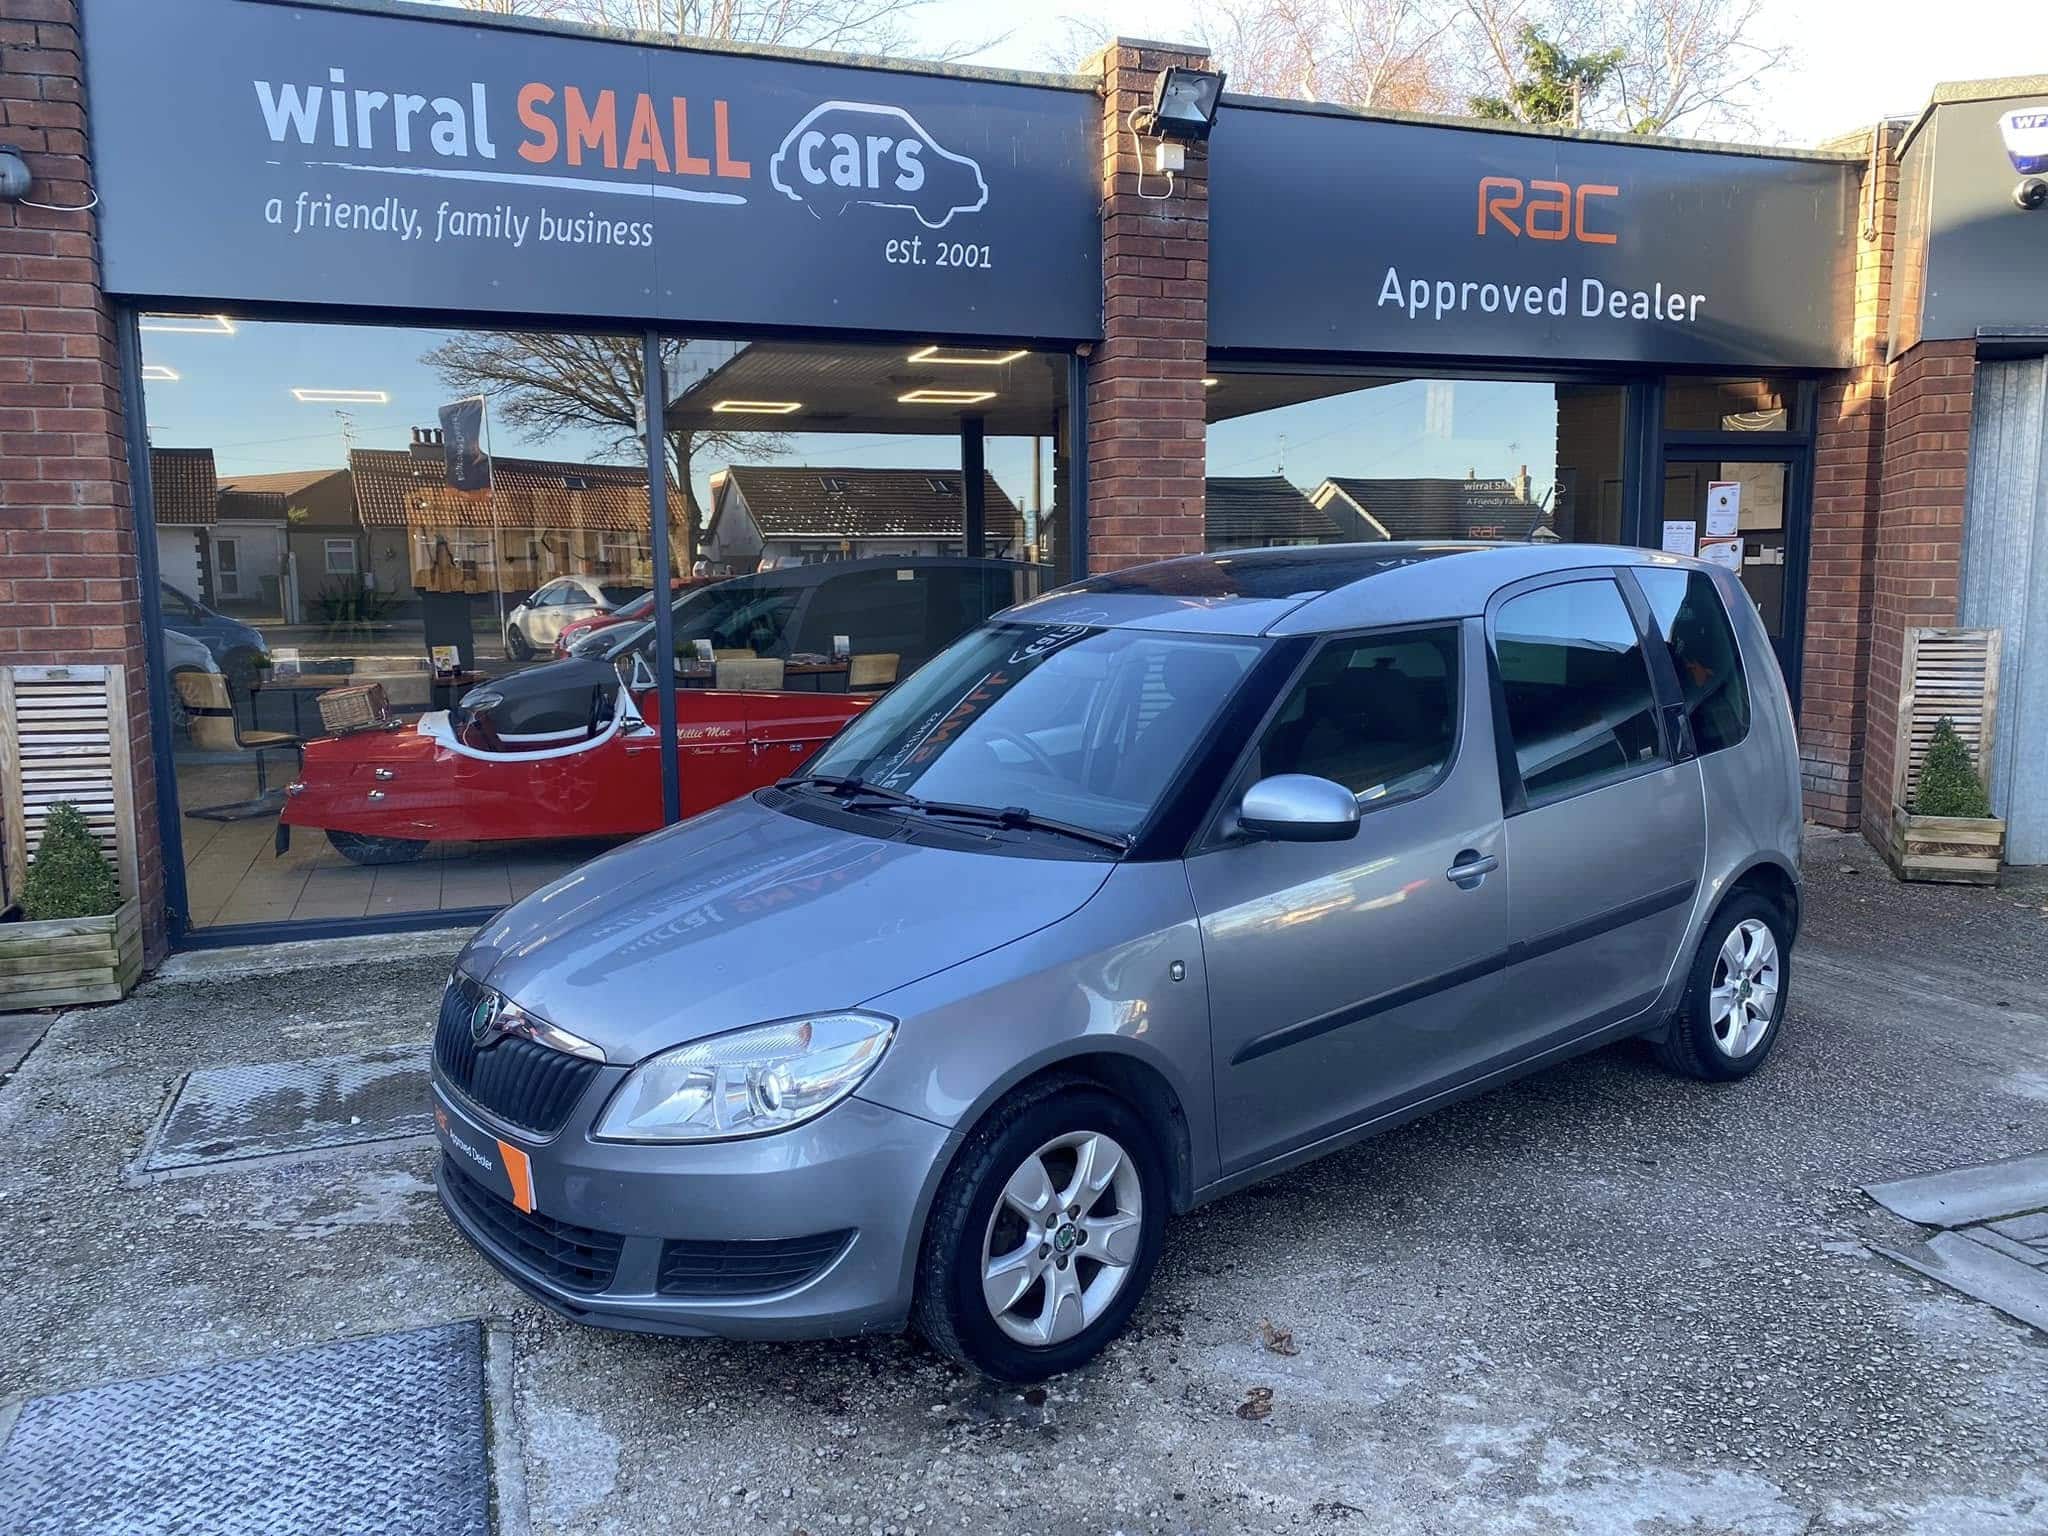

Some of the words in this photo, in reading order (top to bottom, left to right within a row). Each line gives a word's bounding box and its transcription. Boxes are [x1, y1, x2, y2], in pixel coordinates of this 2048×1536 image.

[253, 67, 496, 159] wirral
[516, 82, 751, 179] SMALL
[798, 130, 925, 192] cars
[264, 198, 283, 224] a
[294, 191, 424, 241] friendly,
[434, 201, 530, 248] family
[538, 207, 654, 247] business
[885, 235, 927, 265] est.
[935, 242, 993, 269] 2001
[1377, 266, 1568, 321] Approved
[1581, 278, 1706, 322] Dealer
